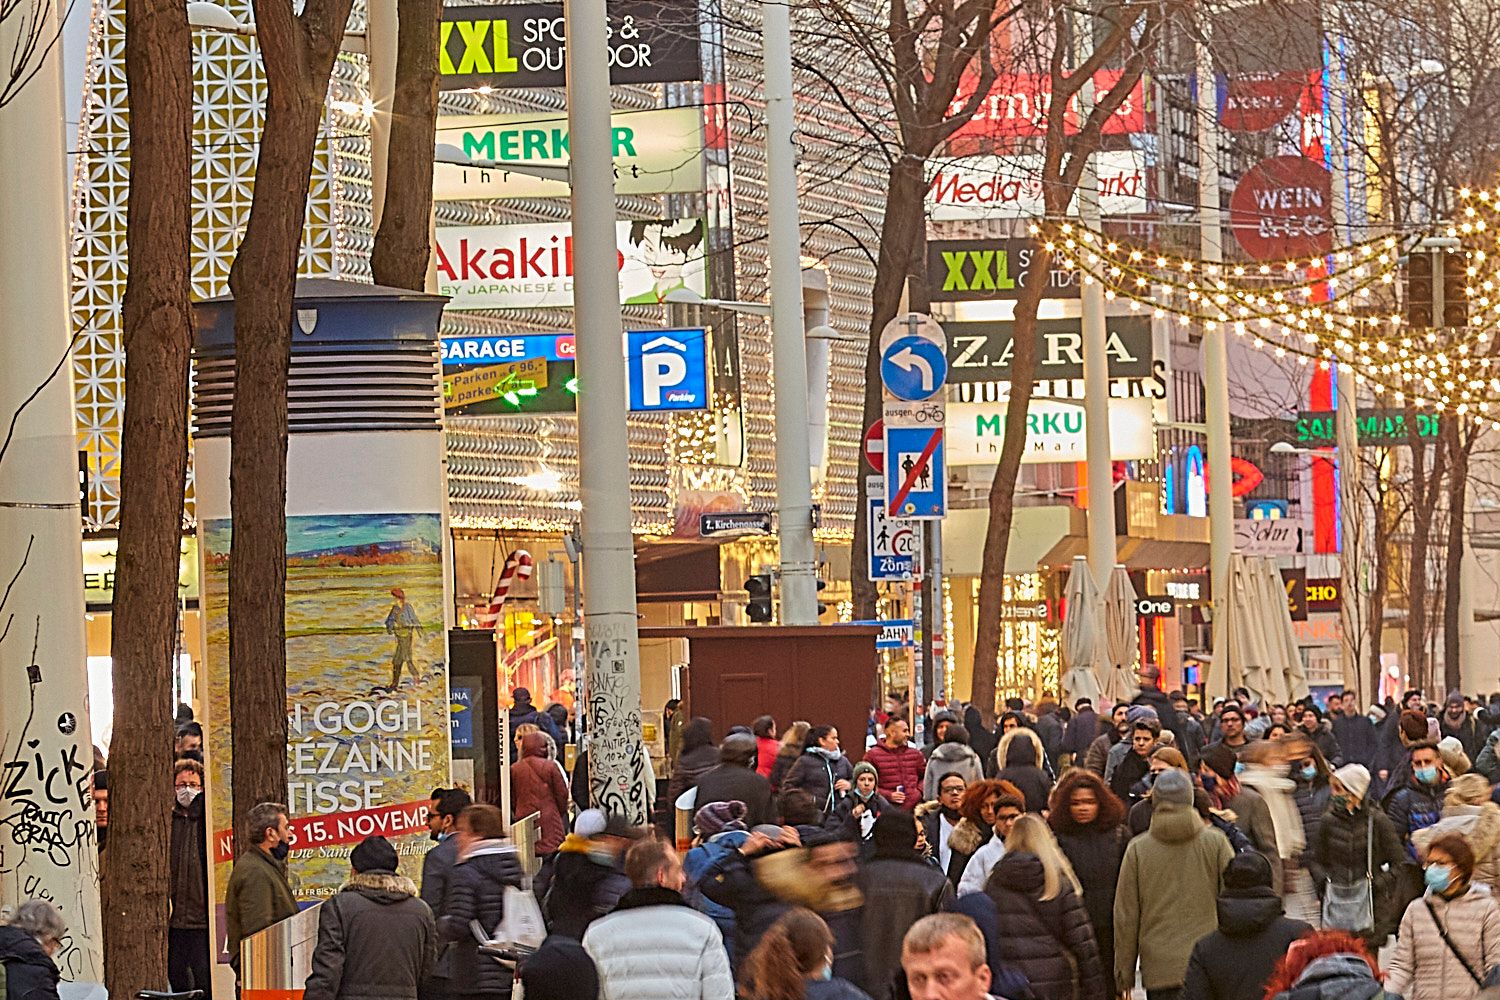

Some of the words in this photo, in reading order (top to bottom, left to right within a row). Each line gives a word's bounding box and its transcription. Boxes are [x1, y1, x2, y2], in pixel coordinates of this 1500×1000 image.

[620, 15, 640, 39] &
[463, 127, 637, 161] MERKR
[931, 171, 1022, 204] Media
[1254, 187, 1323, 209] WEIN
[942, 250, 1015, 291] XXL
[468, 283, 554, 295] JAPANESE
[440, 339, 526, 359] GARAGE
[885, 409, 914, 418] ausgen.
[976, 411, 1083, 437] MRKU
[867, 480, 884, 490] ausg
[715, 520, 765, 530] Kirchengasse
[1305, 586, 1337, 601] CHO
[1139, 600, 1172, 614] One
[313, 699, 422, 734] GOGH
[288, 780, 384, 814] TISSE
[303, 821, 334, 843] 15.
[337, 806, 430, 839] NOVEMB
